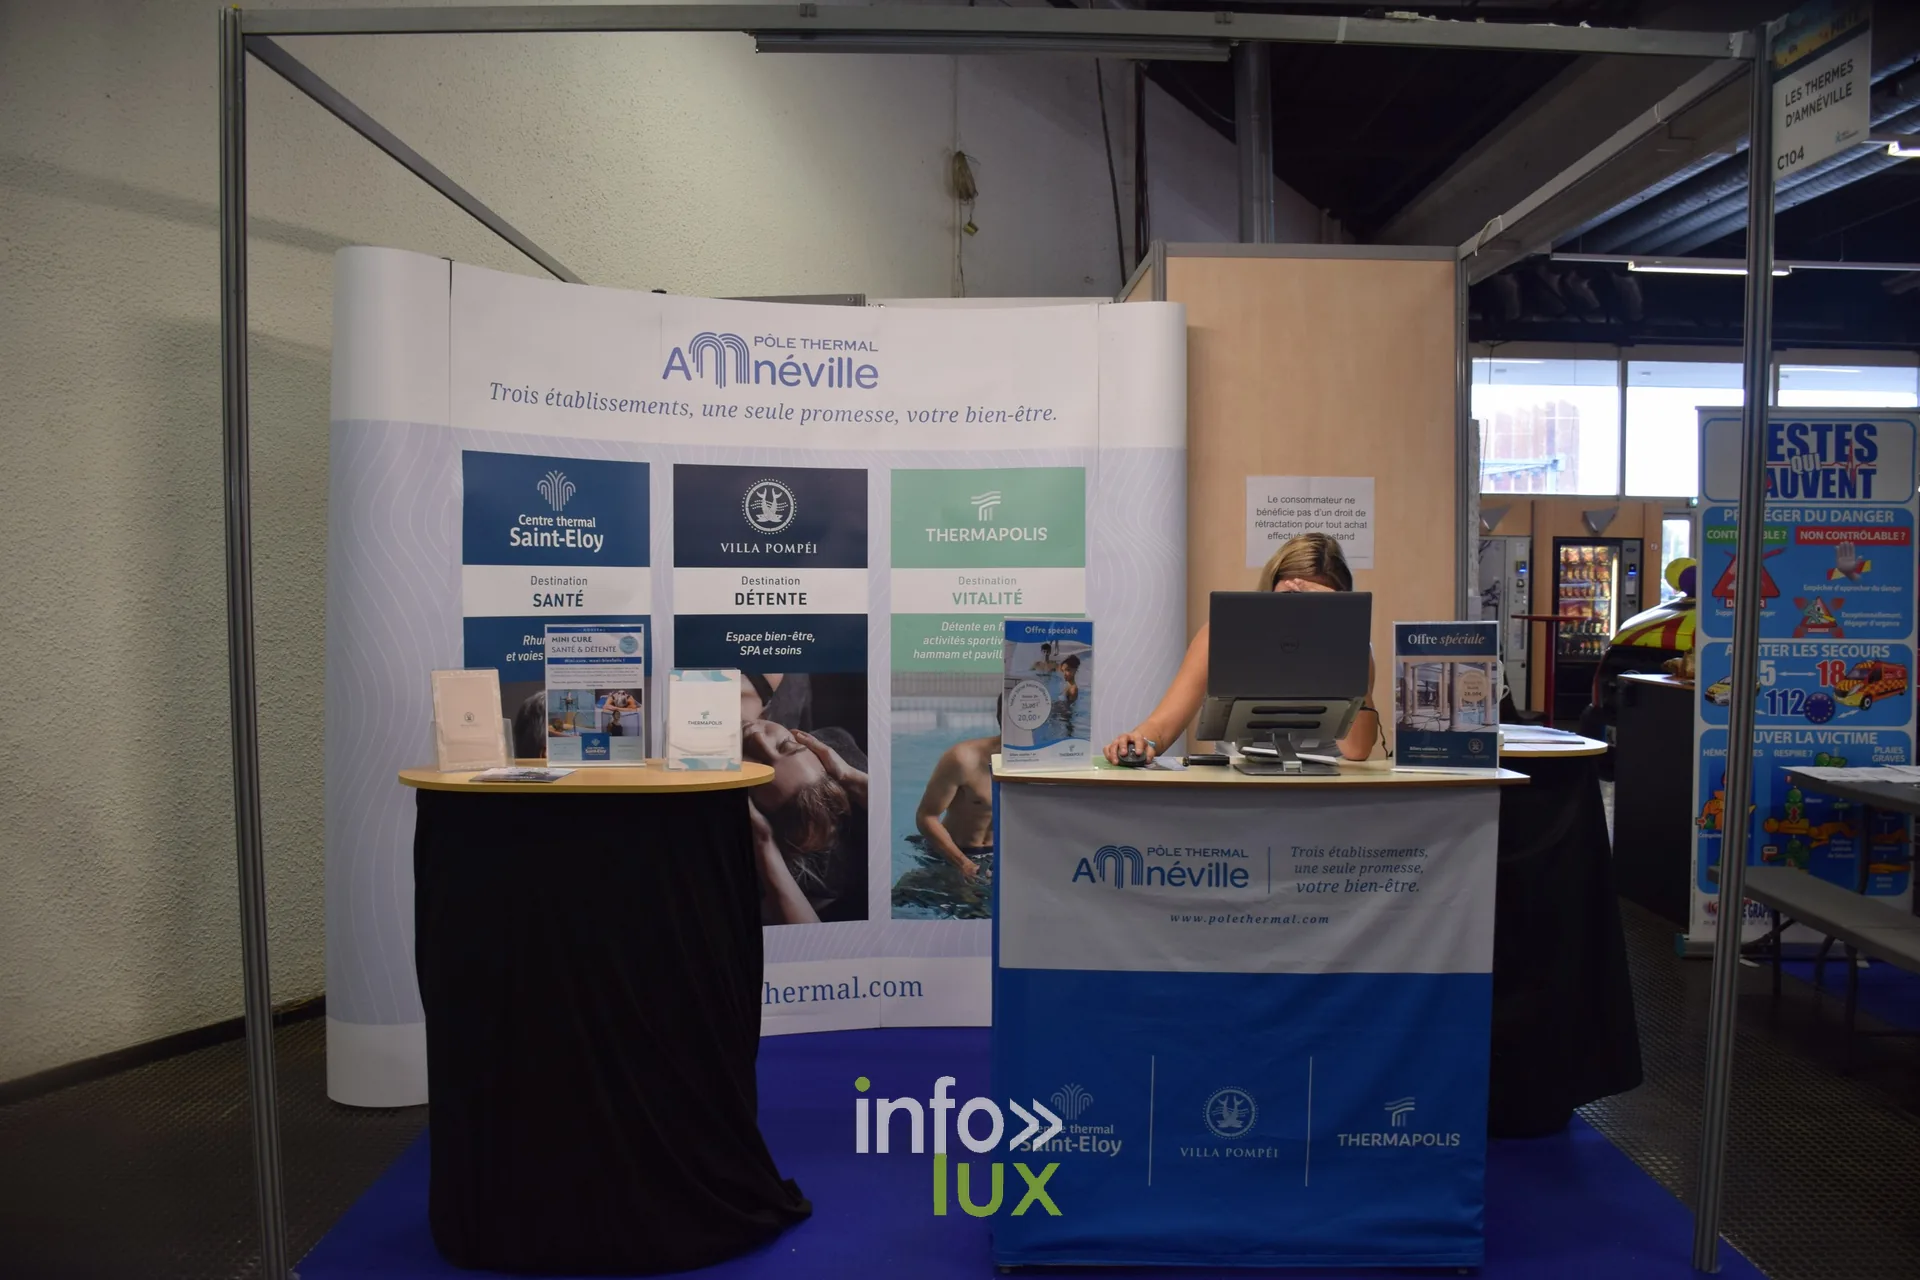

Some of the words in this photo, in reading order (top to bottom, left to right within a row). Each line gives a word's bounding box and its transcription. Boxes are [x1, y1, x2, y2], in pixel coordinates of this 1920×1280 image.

[1784, 87, 1802, 108] LES
[1804, 58, 1854, 95] THERMES
[1785, 82, 1853, 129] D'AMNÉVILLE
[1776, 145, 1805, 171] C104
[753, 333, 796, 351] PÔLE
[799, 336, 879, 353] THERMAL
[490, 382, 539, 406] Trois
[545, 386, 695, 420] établissements,
[702, 403, 739, 420] une
[745, 399, 795, 423] seule
[800, 404, 900, 427] promesse,
[907, 406, 959, 425] votre
[965, 401, 1058, 425] bien-être.
[1767, 422, 1878, 464] ESTES
[1791, 452, 1822, 475] QUI
[1765, 468, 1877, 499] AUVENT
[1267, 495, 1278, 504] Le
[1280, 496, 1342, 505] consommateur
[1344, 497, 1356, 505] ne
[1256, 508, 1295, 517] bénéficie
[1296, 510, 1312, 518] pas
[1314, 508, 1332, 517] d'un
[1334, 508, 1353, 517] droit
[1355, 509, 1366, 517] de
[1804, 510, 1827, 523] DU
[1830, 510, 1895, 523] DANGER
[518, 514, 554, 526] Centre
[556, 515, 596, 528] thermal
[1255, 519, 1303, 529] rétractation
[1304, 521, 1323, 530] pour
[1325, 520, 1342, 529] tout
[1344, 521, 1367, 530] achat
[510, 527, 604, 553] Saint-Eloy
[925, 527, 1048, 542] THERMAPOLIS
[1332, 532, 1355, 541] stand
[1800, 531, 1824, 541] NON
[1825, 530, 1899, 541] CONTRÔLABLE
[720, 543, 760, 554] VILLA
[765, 542, 818, 554] POMPÉI
[531, 575, 588, 586] Destination
[741, 576, 801, 586] Destination
[958, 575, 1017, 586] Destination
[533, 589, 584, 607] SANTÉ
[735, 589, 808, 606] DÉTENTE
[952, 588, 1023, 605] VITALITÉ
[941, 621, 981, 632] Détente
[983, 623, 996, 632] en
[1024, 626, 1046, 635] Offre
[551, 635, 570, 643] MINI
[571, 635, 593, 643] CURE
[726, 631, 763, 644] Espace
[765, 630, 816, 643] bien-être,
[923, 635, 966, 646] activités
[1407, 633, 1438, 645] Offre
[1439, 632, 1486, 647] spéciale
[551, 645, 575, 653] SANTÉ
[740, 646, 761, 656] SPA
[763, 646, 773, 656] et
[774, 645, 802, 656] soins
[913, 650, 960, 660] hammam
[962, 649, 973, 659] et
[1796, 645, 1819, 658] LES
[1821, 645, 1890, 659] SECOURS
[506, 652, 516, 662] et
[518, 651, 544, 662] voies
[1759, 660, 1776, 686] 5
[1816, 660, 1846, 688] 18
[1764, 688, 1806, 716] 112
[1795, 731, 1817, 745] LA
[1818, 731, 1878, 746] VICTIME
[1874, 746, 1903, 755] PLAIES
[1872, 754, 1906, 763] GRAVES
[1147, 844, 1182, 858] PÔLE
[1185, 847, 1249, 859] THERMAL
[1291, 845, 1326, 859] Trois
[1329, 844, 1429, 862] établissements,
[1294, 864, 1318, 876] une
[1322, 862, 1355, 875] seule
[1358, 863, 1425, 878] promesse,
[1296, 881, 1340, 894] votre
[1344, 878, 1421, 894] bien-être.
[1170, 912, 1331, 926] www.polethermal.com
[762, 976, 924, 1005] hermal.com
[1069, 1123, 1115, 1135] thermal
[1337, 1132, 1461, 1147] THERMAPOLIS
[1180, 1147, 1220, 1159] VILLA
[1225, 1145, 1279, 1160] POMPÉI
